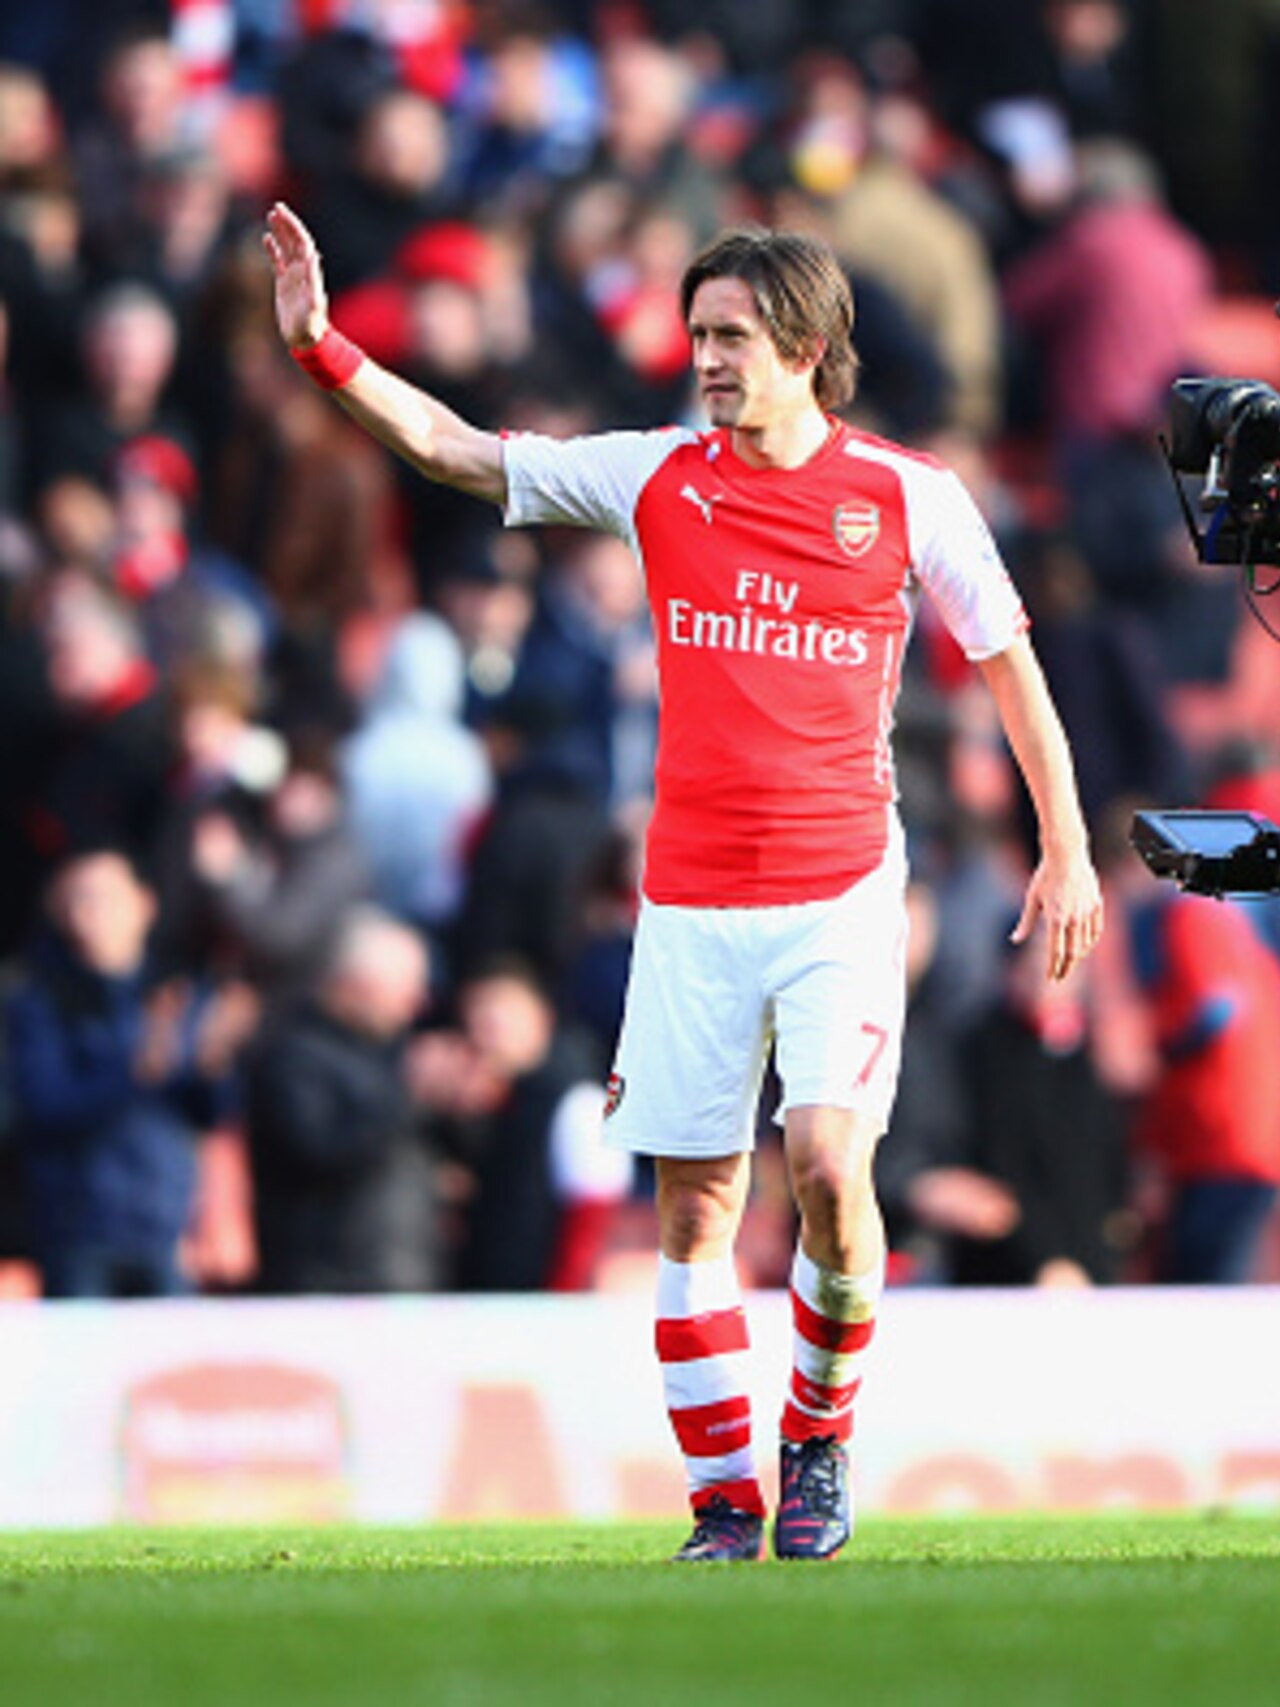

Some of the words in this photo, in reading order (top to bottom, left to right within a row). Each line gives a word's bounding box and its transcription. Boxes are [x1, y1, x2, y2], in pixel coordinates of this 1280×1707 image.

[736, 570, 799, 613] Fly
[667, 599, 869, 667] Emirates
[855, 1021, 889, 1088] 7
